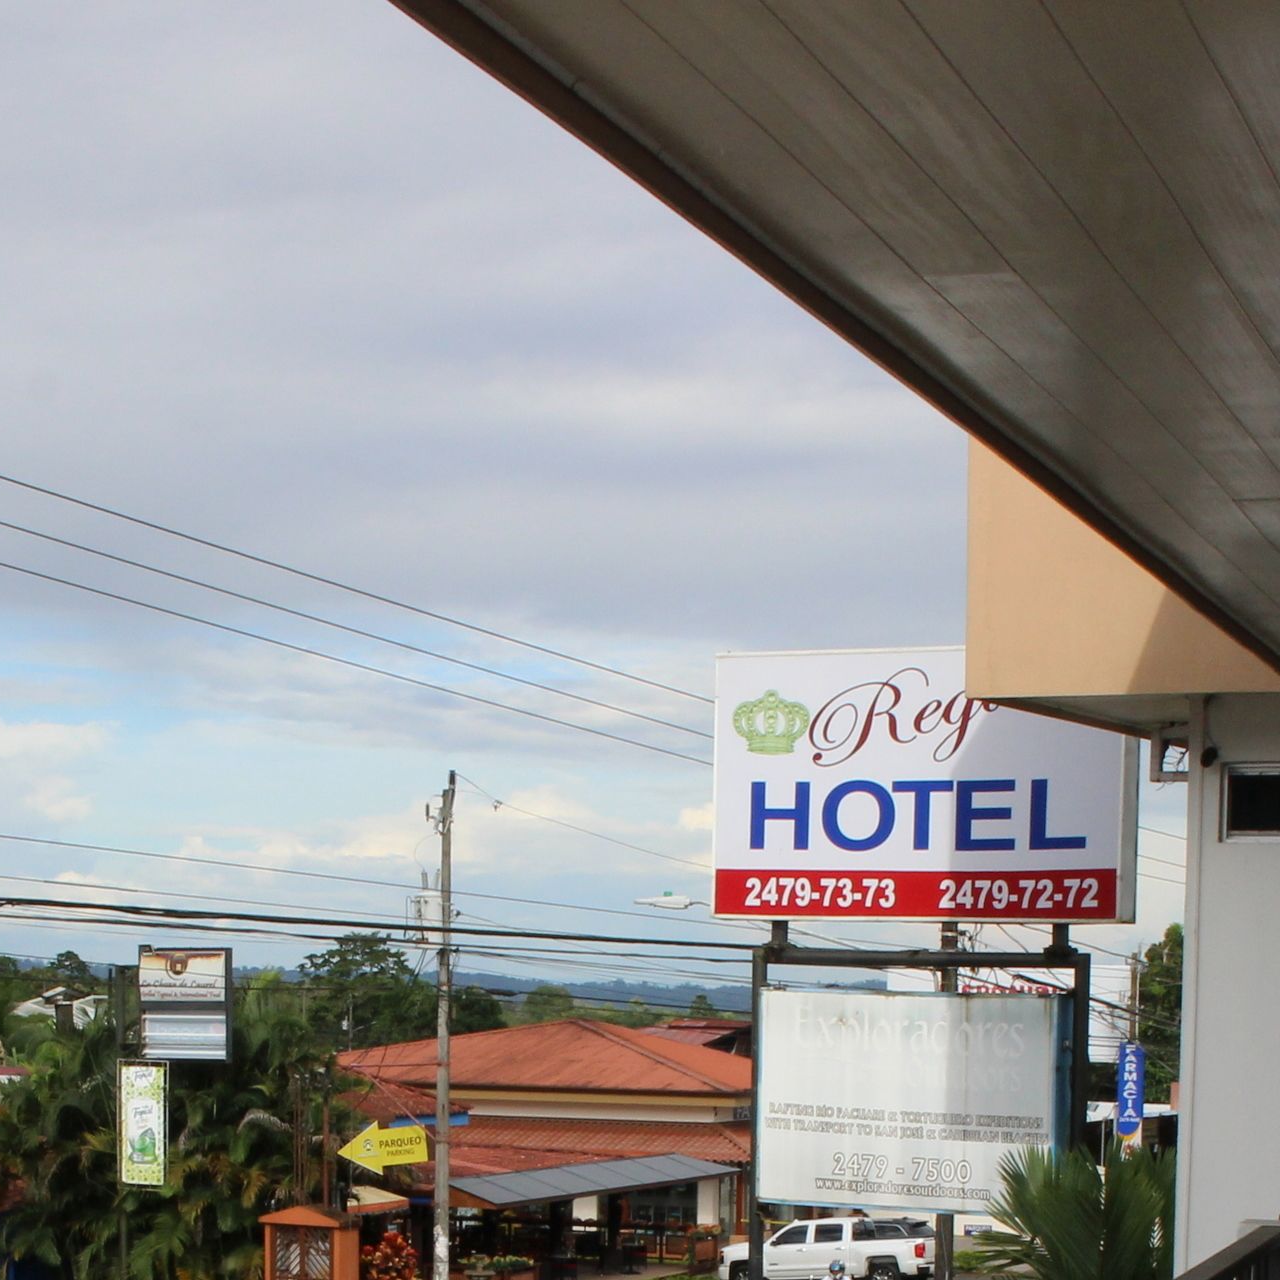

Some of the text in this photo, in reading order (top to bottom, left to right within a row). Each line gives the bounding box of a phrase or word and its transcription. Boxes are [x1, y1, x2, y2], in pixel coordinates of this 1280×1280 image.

[808, 667, 998, 767] Reg
[749, 778, 1088, 852] HOTEL
[744, 876, 1099, 910] 2479-73-73 2479-72-72
[1121, 1044, 1138, 1118] FARMACIA
[379, 1136, 422, 1149] PARQUEO
[765, 1116, 792, 1131] WITH
[793, 1118, 855, 1135] TRANSPORT
[856, 1123, 873, 1136] TO
[875, 1125, 898, 1139] SAN
[386, 1147, 416, 1157] PARKING
[832, 1151, 889, 1179] 2479
[911, 1156, 972, 1184] 7500
[815, 1177, 991, 1201] www.exploradoresoutdoors.com
